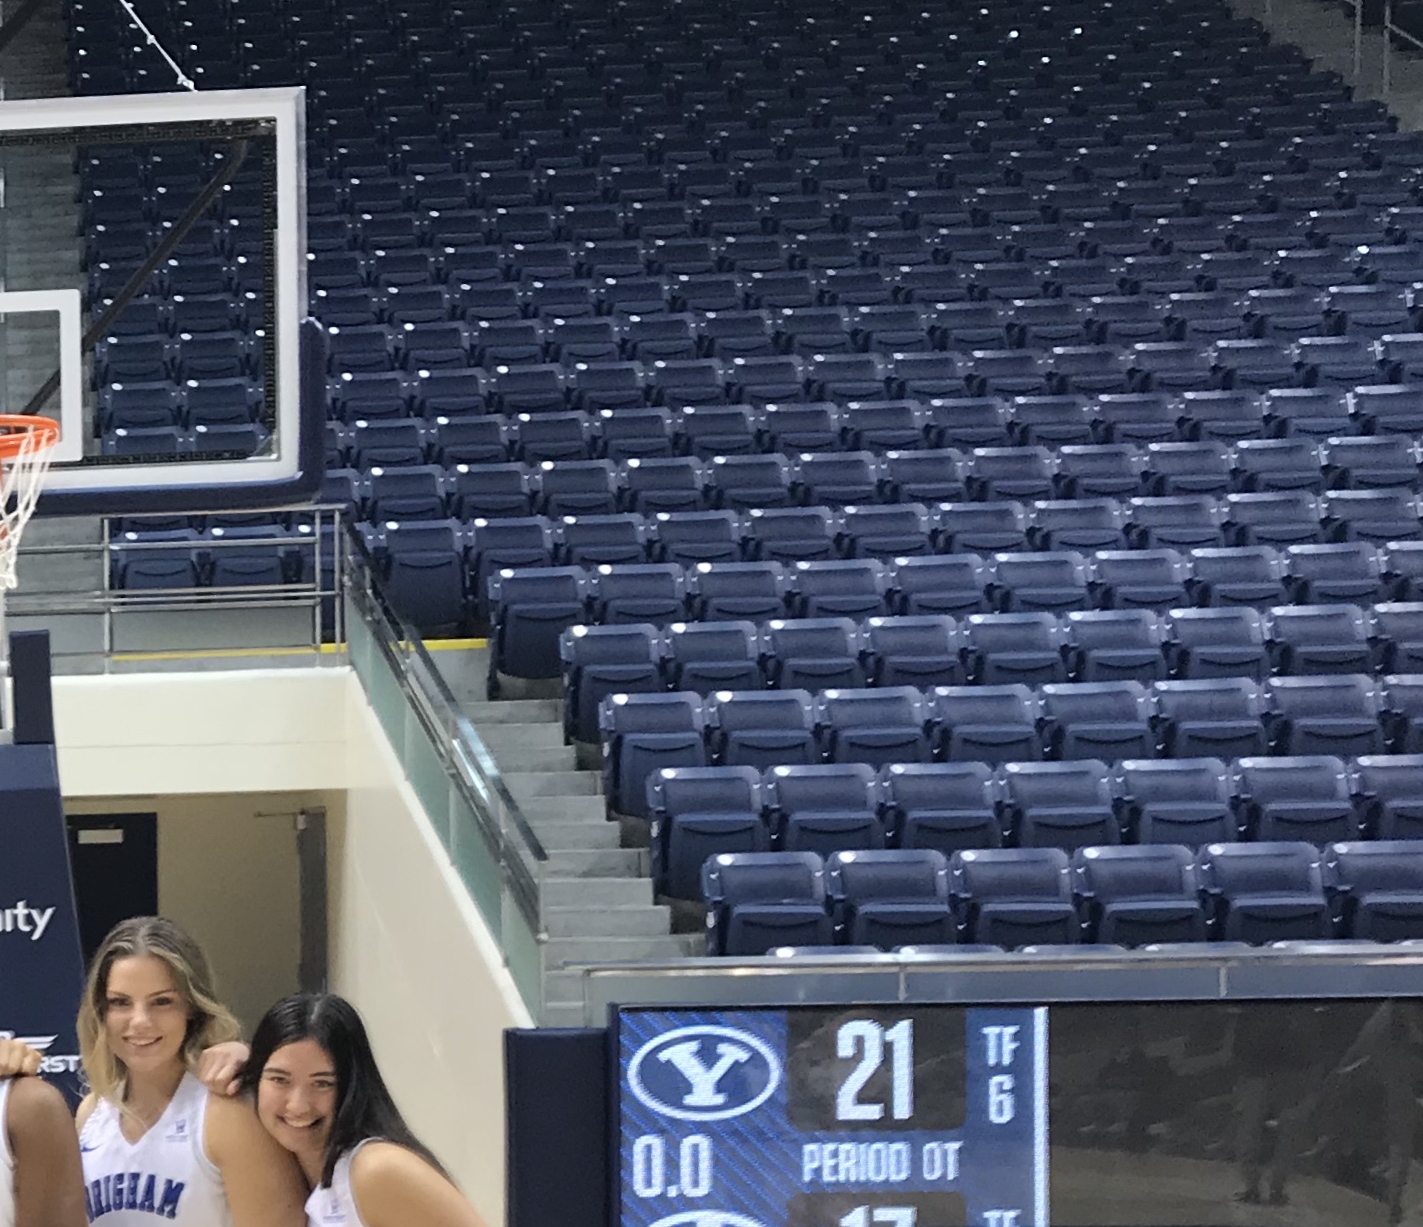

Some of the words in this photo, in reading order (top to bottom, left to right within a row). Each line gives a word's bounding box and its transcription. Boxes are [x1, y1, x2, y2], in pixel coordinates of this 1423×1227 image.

[836, 1018, 914, 1121] 21
[982, 1025, 1020, 1067] TF
[988, 1075, 1015, 1125] 6
[632, 1134, 714, 1198] 0.0
[801, 1141, 912, 1183] PERIOD
[922, 1140, 964, 1181] OT
